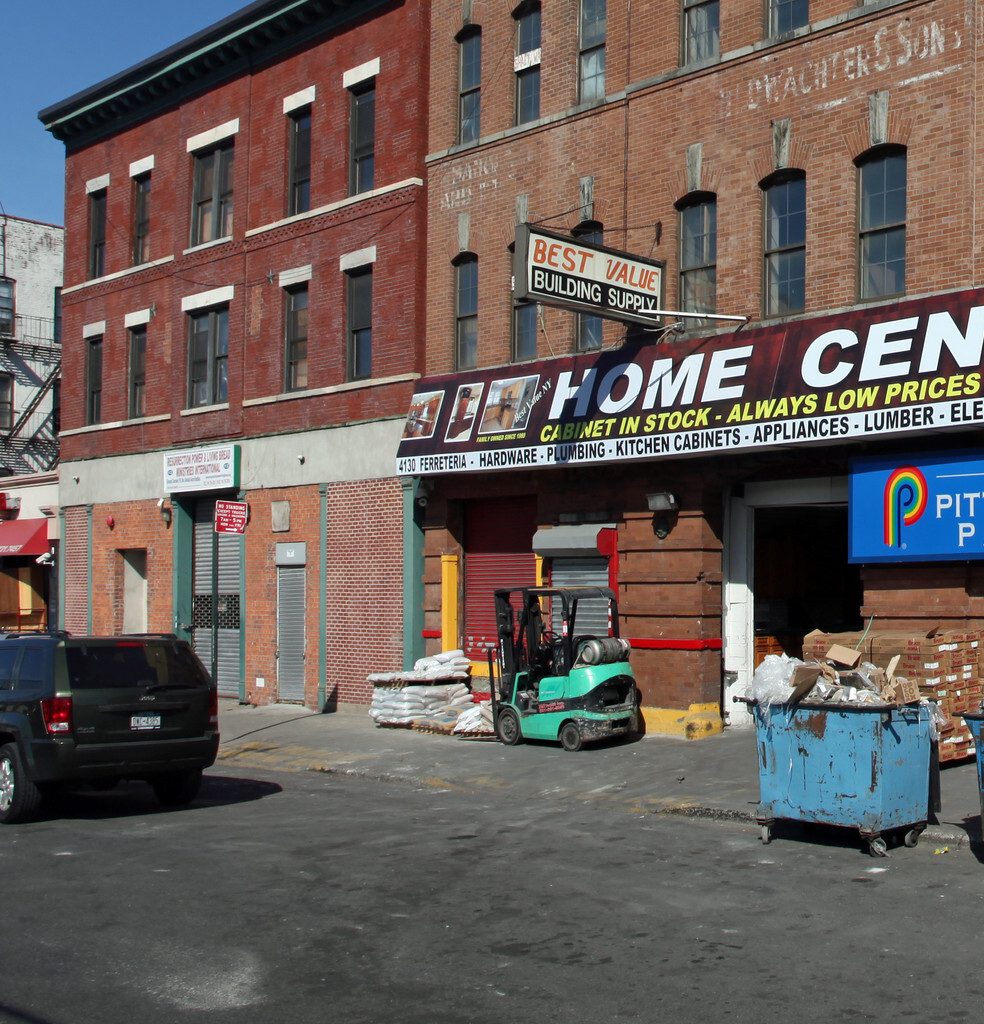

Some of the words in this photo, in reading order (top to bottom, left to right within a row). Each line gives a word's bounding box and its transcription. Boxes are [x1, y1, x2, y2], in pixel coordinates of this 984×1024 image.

[534, 239, 594, 273] BEST
[606, 259, 659, 291] VALUE
[534, 270, 602, 303] BUILDING
[608, 288, 655, 310] SUPPLY
[514, 406, 527, 423] Best
[542, 378, 552, 394] NY
[540, 418, 616, 443] CABINET
[618, 415, 641, 436] IN
[644, 407, 712, 433] STOCK
[726, 393, 818, 423] ALWAYS
[824, 386, 880, 412] LOW
[884, 372, 982, 404] PRICES
[548, 345, 754, 420] HOME
[399, 458, 416, 472] 4130
[420, 454, 466, 472] FERRETERIA
[480, 448, 537, 468] HARDWARE
[547, 442, 606, 462] PLUMBING
[616, 435, 670, 456] KITCHEN
[674, 428, 740, 452] CABINETS
[754, 416, 849, 443] APPLIANCES
[864, 407, 934, 432] LUMBER
